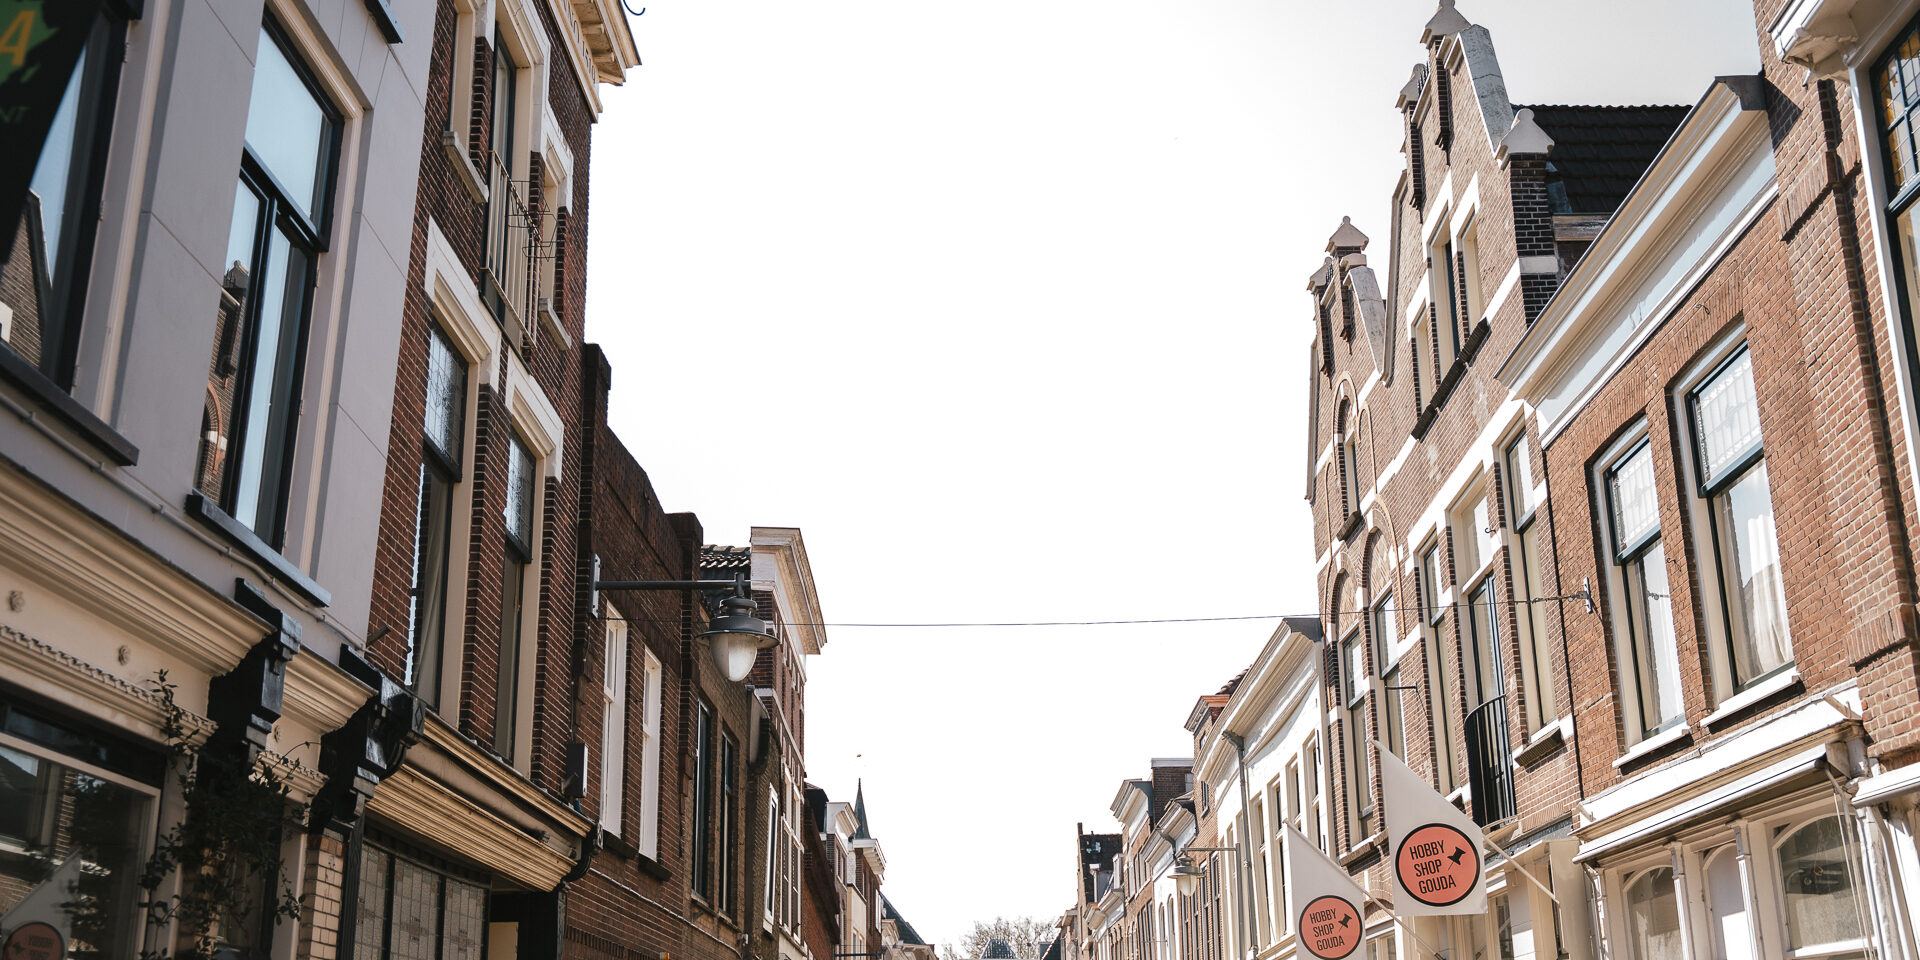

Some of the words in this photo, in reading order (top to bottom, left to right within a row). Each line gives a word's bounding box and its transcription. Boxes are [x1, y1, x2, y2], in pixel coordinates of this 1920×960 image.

[1409, 840, 1444, 860] HOBBY
[1414, 859, 1442, 877] SHOP
[1418, 875, 1456, 894] GOUDA
[1309, 908, 1336, 924] HOBBY
[1313, 923, 1334, 937] SHOP
[1316, 935, 1345, 951] GOUDA
